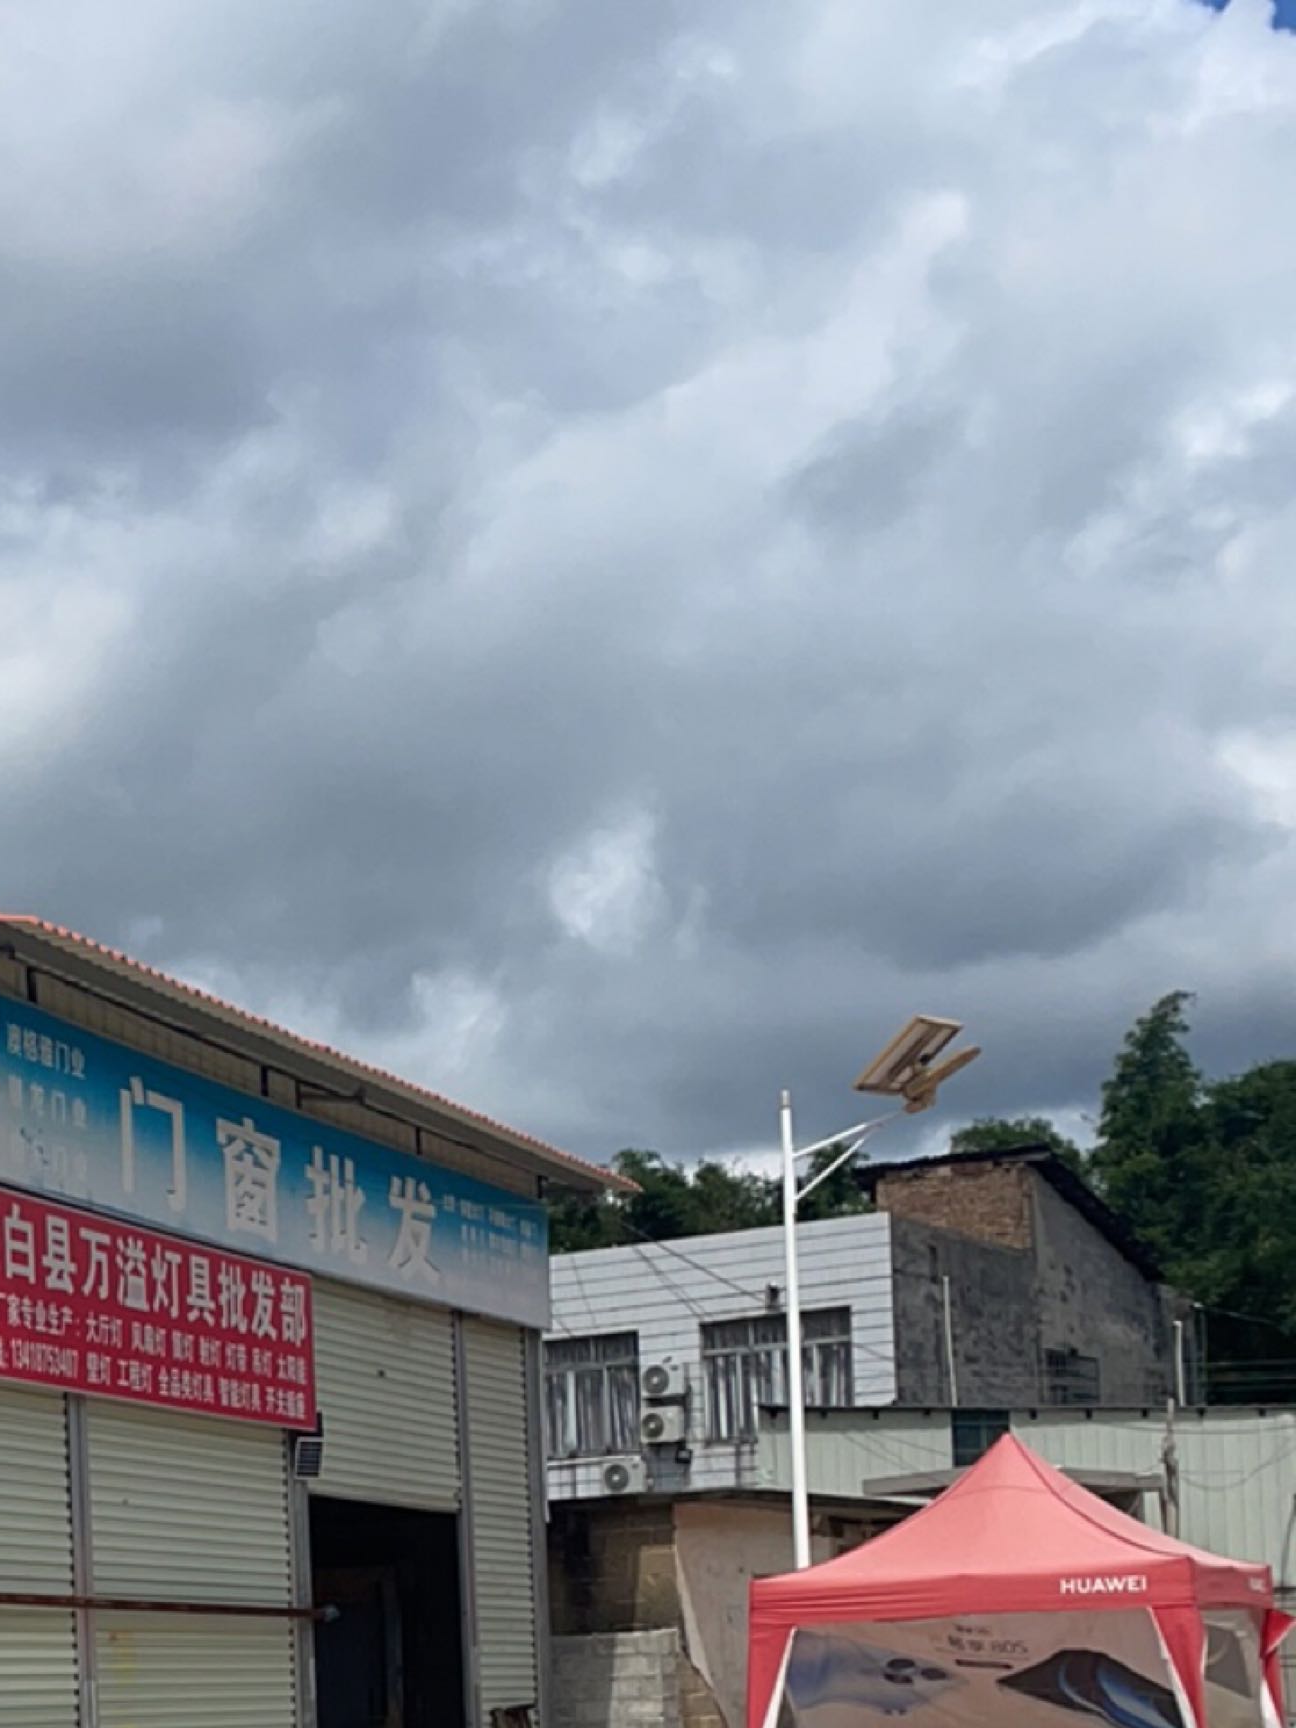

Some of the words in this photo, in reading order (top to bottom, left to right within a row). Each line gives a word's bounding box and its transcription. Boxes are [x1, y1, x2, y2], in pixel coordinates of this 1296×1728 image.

[119, 1076, 441, 1287] 门窗批发
[1060, 1575, 1147, 1594] HUAWEI
